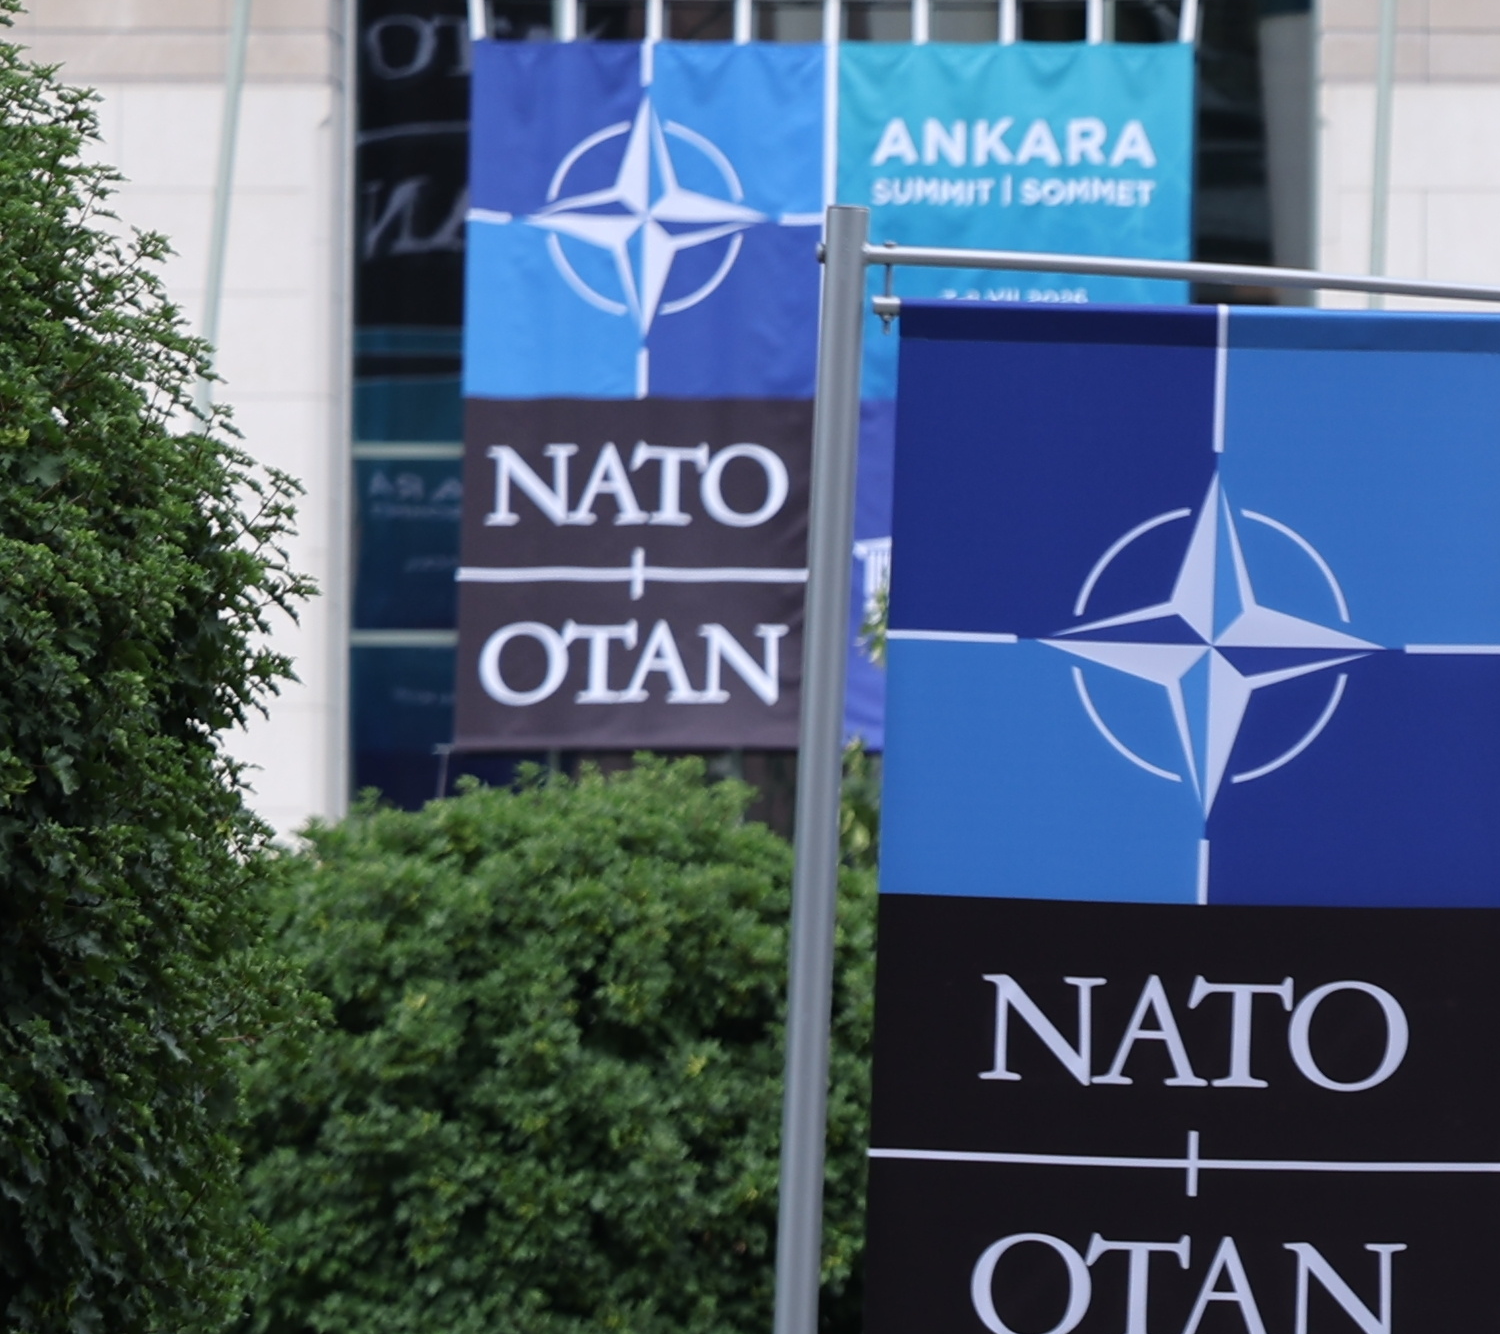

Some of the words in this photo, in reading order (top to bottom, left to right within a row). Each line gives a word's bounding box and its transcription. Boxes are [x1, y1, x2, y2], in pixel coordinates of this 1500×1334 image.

[873, 117, 1156, 167] ANKARA
[872, 177, 995, 206] SUMMIT
[1021, 177, 1155, 206] SOMMET
[486, 442, 788, 526] NATO
[480, 620, 788, 705] OTAN
[979, 974, 1408, 1091] NATO
